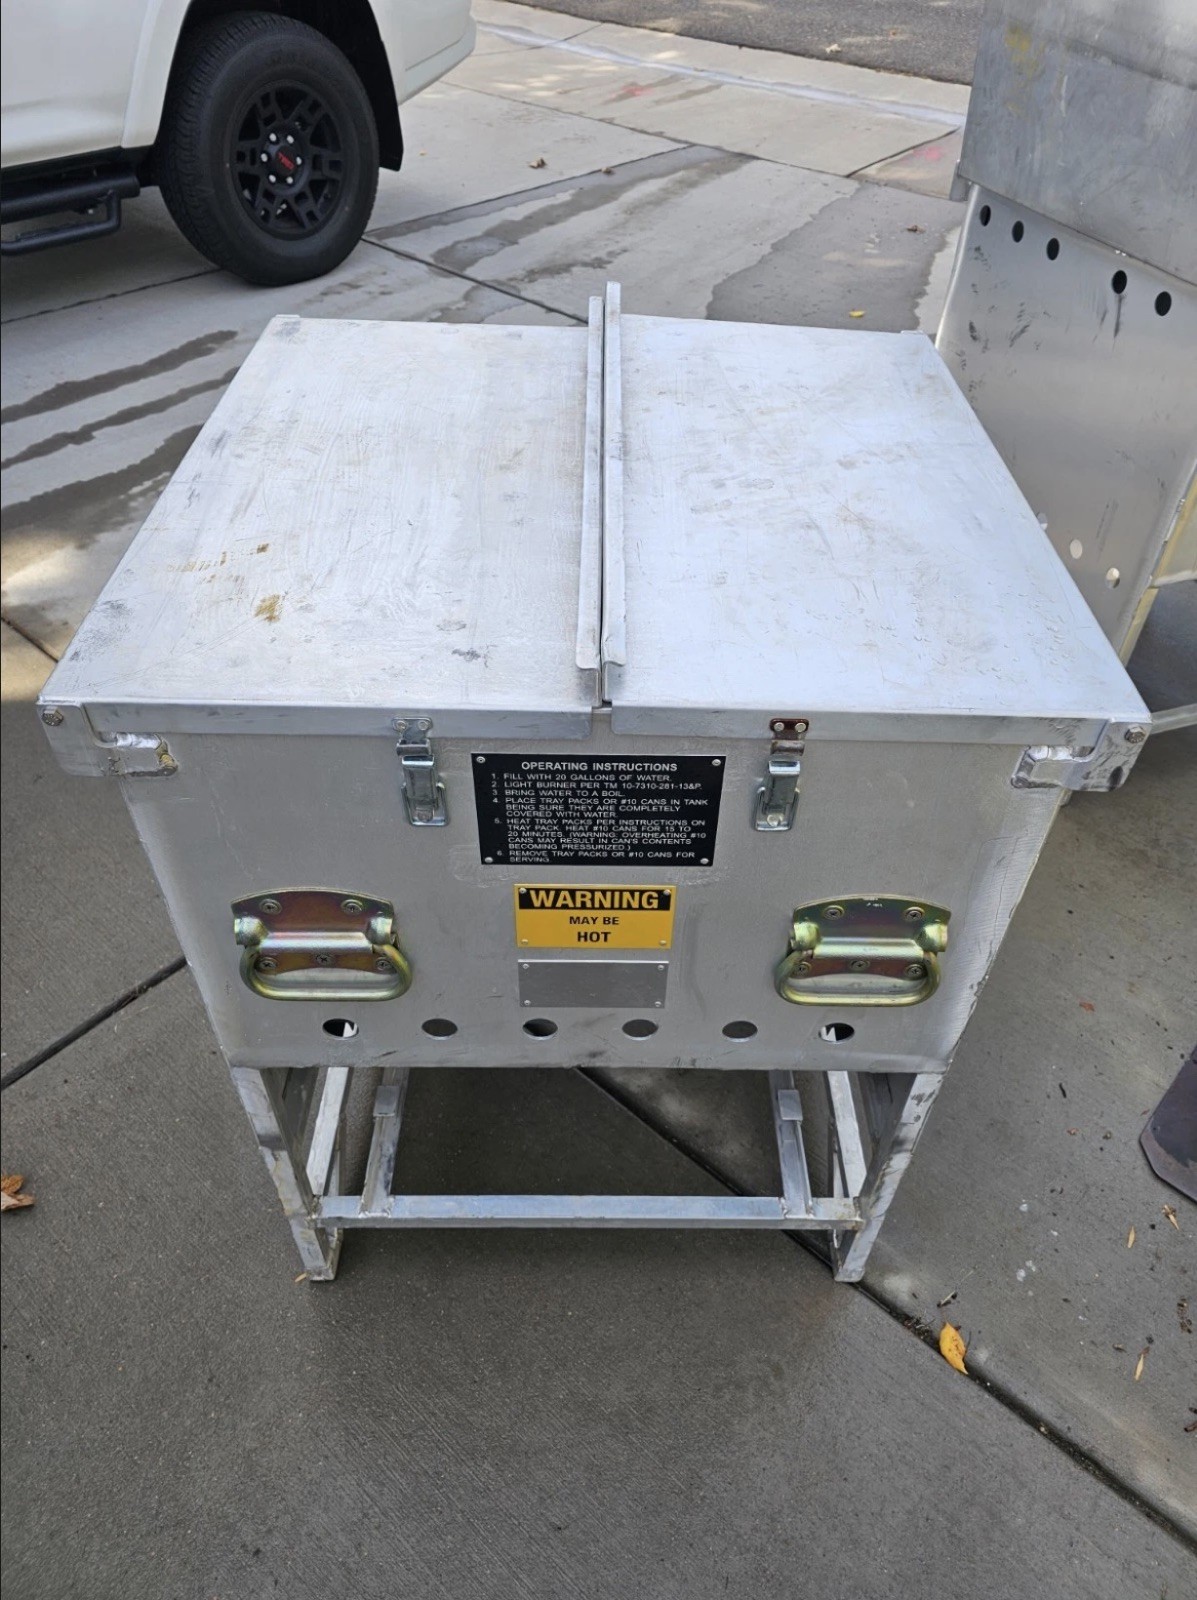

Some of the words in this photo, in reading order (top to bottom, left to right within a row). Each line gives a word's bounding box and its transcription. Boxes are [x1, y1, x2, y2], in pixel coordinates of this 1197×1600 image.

[521, 762, 587, 770] OPERATING
[593, 763, 677, 771] INSTRUCTIONS
[530, 890, 659, 909] WARNING
[569, 917, 599, 925] MAY
[603, 917, 619, 925] BE
[577, 932, 611, 942] HOT
